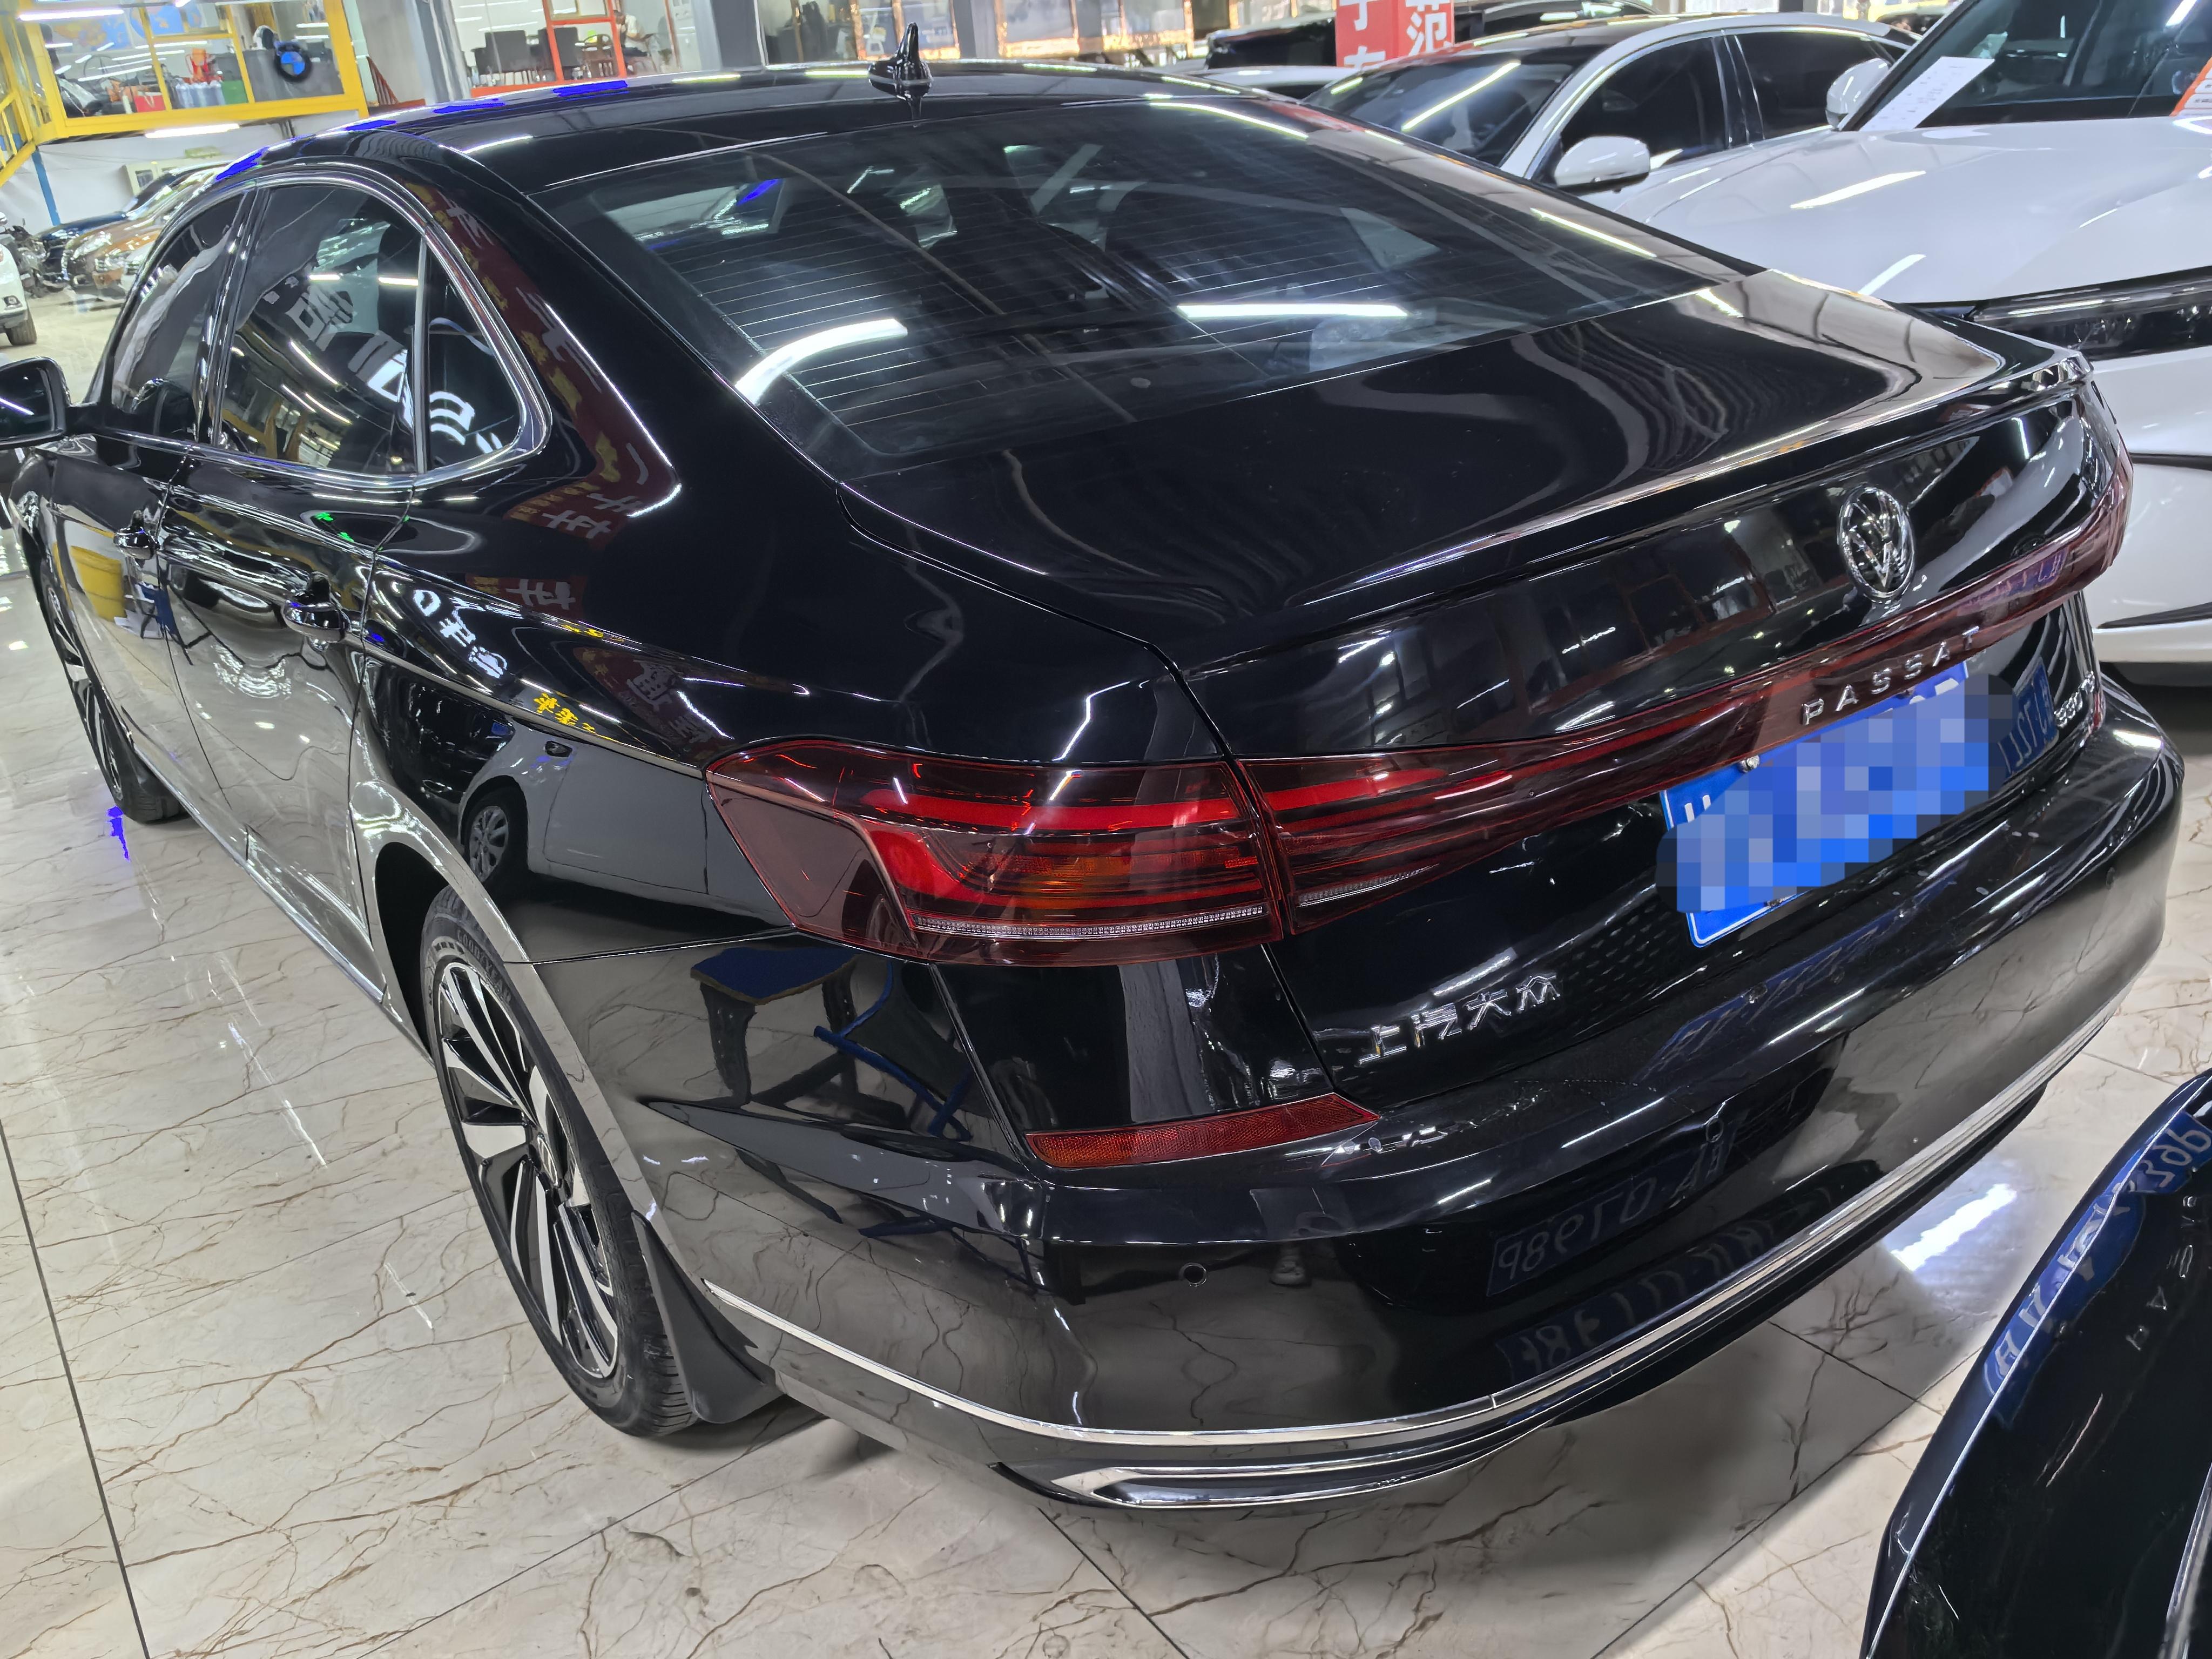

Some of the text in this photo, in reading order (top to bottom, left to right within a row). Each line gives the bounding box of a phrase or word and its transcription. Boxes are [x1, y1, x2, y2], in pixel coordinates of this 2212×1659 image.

[1802, 625, 1979, 725] PASSAT
[1355, 972, 1560, 1067] 上汽大众
